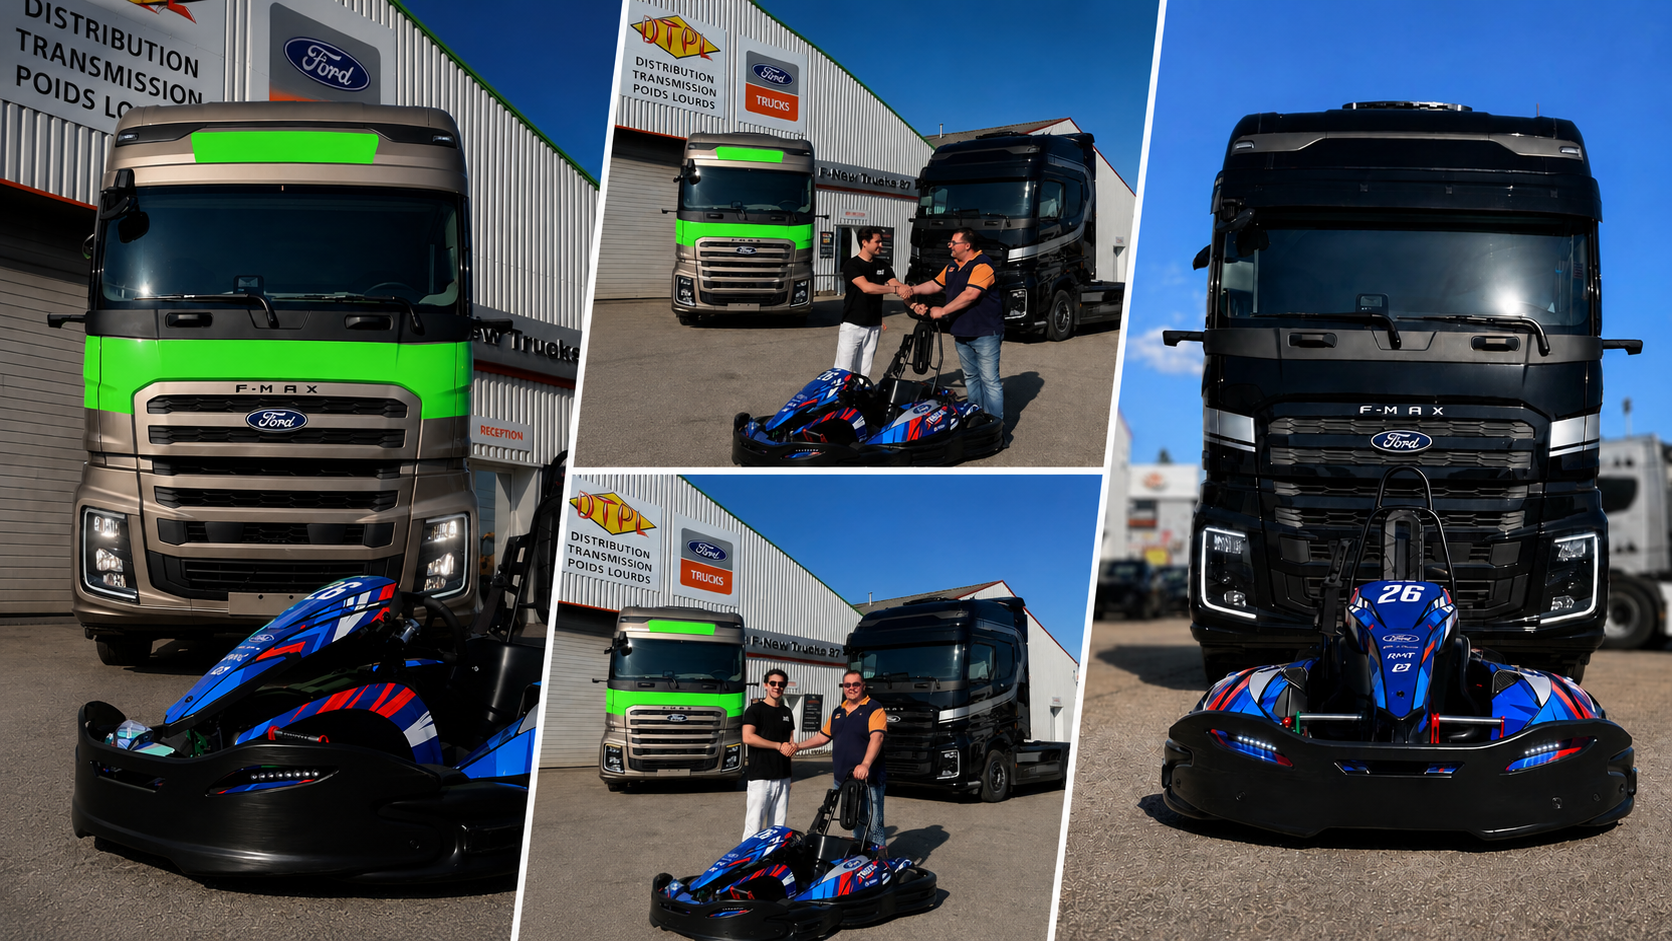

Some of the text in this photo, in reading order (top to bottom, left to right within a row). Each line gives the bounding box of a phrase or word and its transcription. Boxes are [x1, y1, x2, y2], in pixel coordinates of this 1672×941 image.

[25, 0, 199, 78] DISTRIBUTION
[641, 15, 713, 61] DTPL
[16, 27, 202, 104] TRANSMISSION
[302, 45, 354, 85] Ford
[636, 57, 715, 83] DISTRIBUTION
[16, 64, 96, 110] POIDS
[632, 70, 717, 97] TRANSMISSION
[633, 84, 715, 109] POIDS LOURDS
[756, 95, 790, 112] TRUCKS
[480, 425, 523, 440] RECEPTION
[577, 490, 649, 538] DTPL
[567, 544, 652, 572] TRANSMISSION
[571, 531, 650, 559] DISTRIBUTION
[568, 558, 651, 584] POIDS LOURDS
[690, 569, 724, 586] TRUCKS
[1377, 585, 1425, 604] 26
